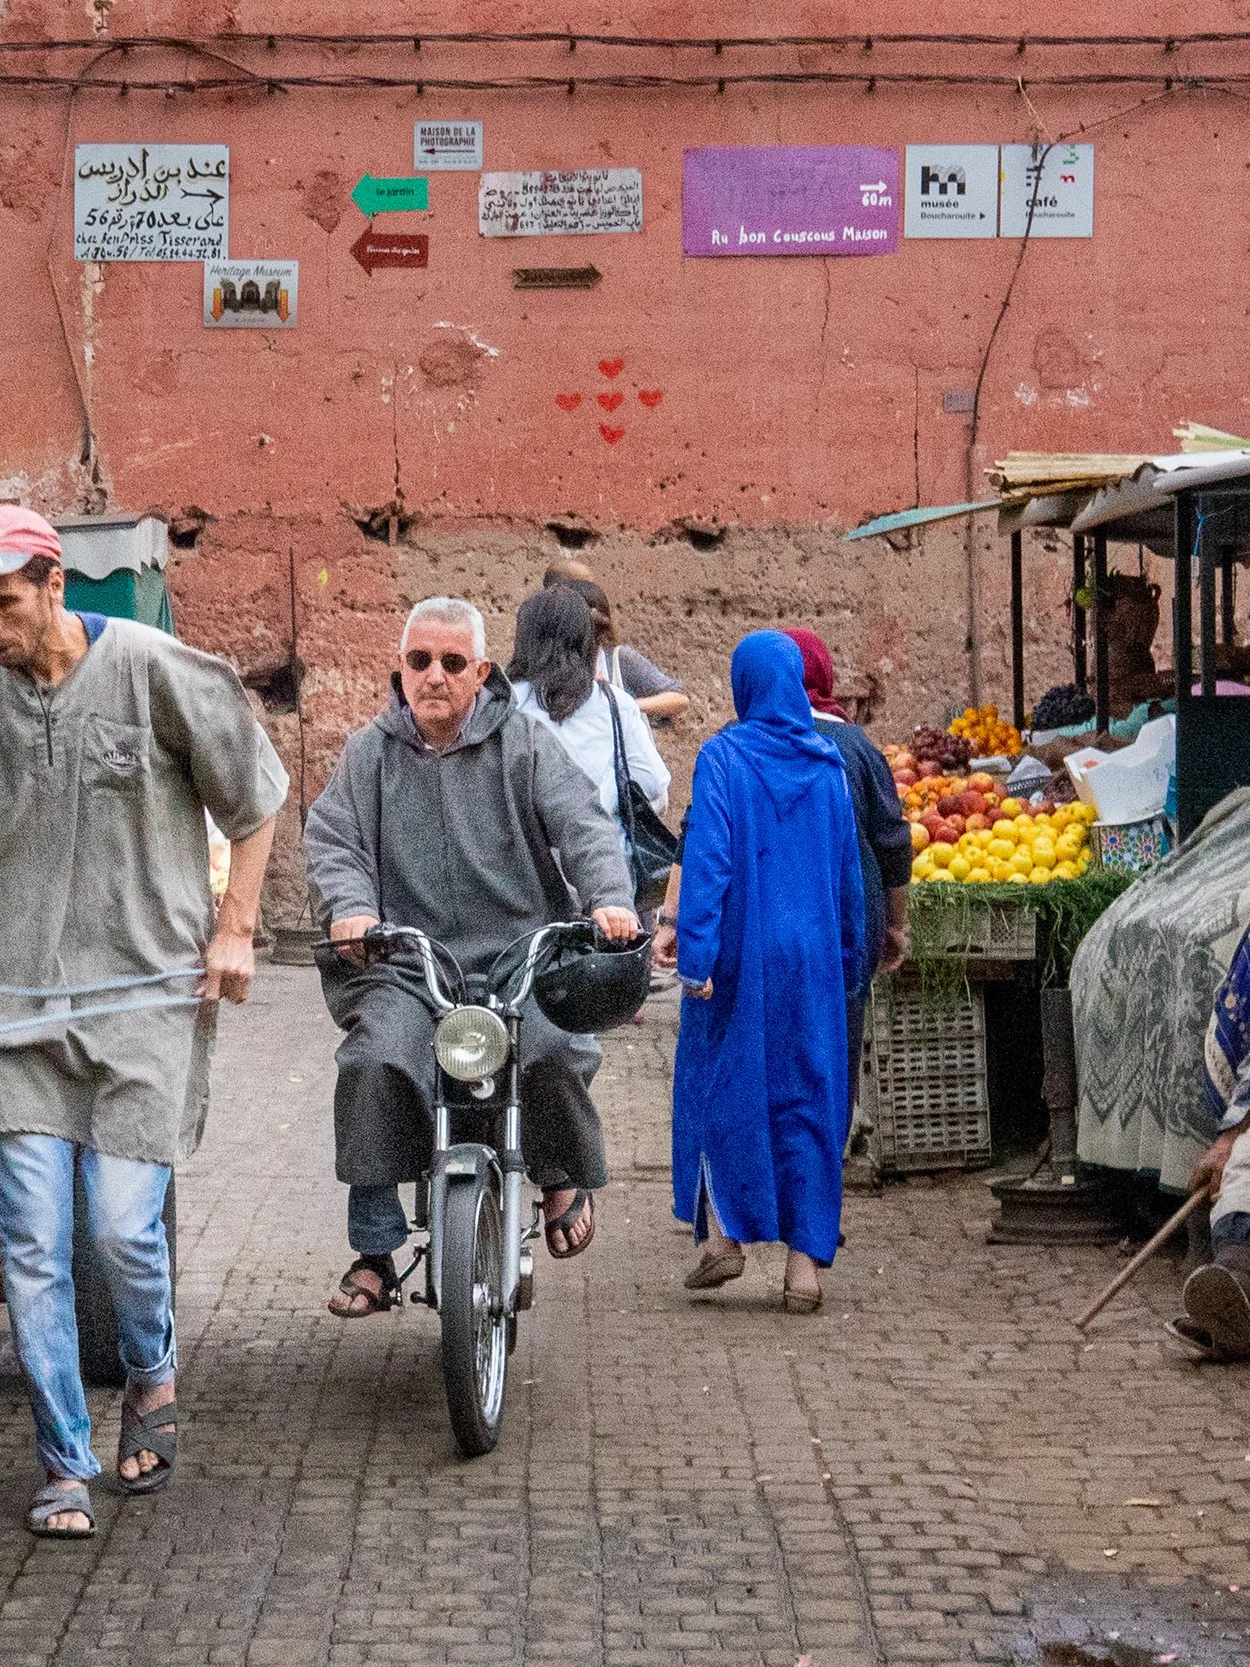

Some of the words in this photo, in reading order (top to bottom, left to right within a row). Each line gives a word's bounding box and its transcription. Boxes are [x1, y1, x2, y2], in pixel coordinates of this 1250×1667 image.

[420, 126, 451, 136] MAISON
[453, 126, 463, 136] DE
[466, 126, 476, 136] LA
[420, 137, 475, 146] PHOTOGRAPHIE
[153, 166, 181, 184] بن
[187, 157, 226, 179] عند
[376, 187, 385, 197] le
[921, 198, 959, 209] musée
[1026, 195, 1058, 208] café
[84, 208, 109, 226] 56
[739, 225, 766, 245] bon
[773, 229, 835, 244] Couscous
[843, 226, 888, 242] Maison
[210, 264, 251, 281] Heritage
[252, 264, 292, 277] Museum
